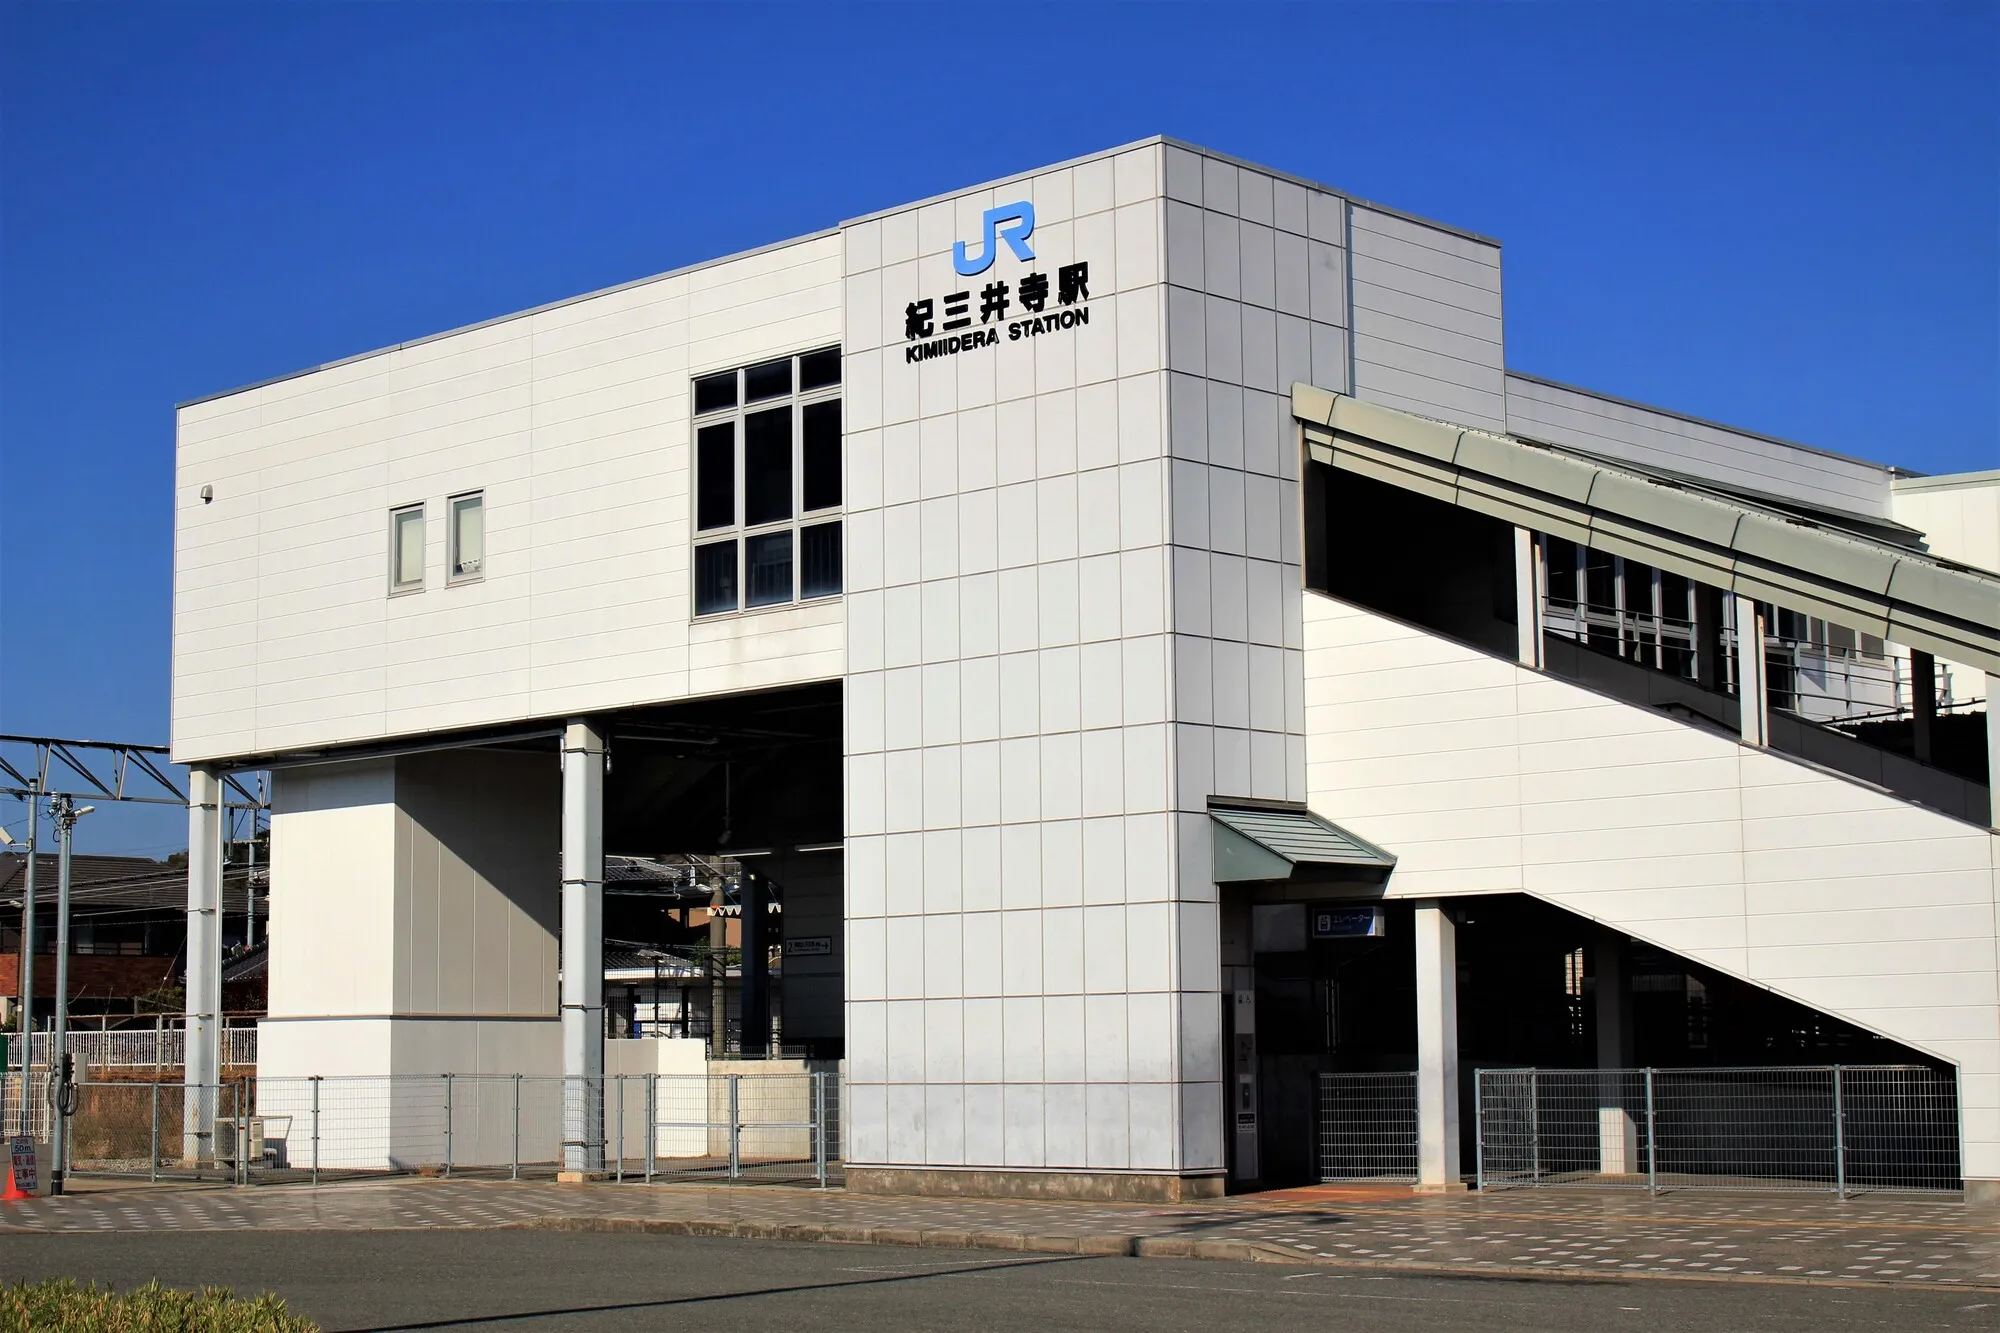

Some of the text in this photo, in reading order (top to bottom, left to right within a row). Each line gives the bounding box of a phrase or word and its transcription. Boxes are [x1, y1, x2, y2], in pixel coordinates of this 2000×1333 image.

[953, 200, 1036, 276] JR
[905, 261, 1089, 341] 紀三井寺駅
[905, 307, 1089, 364] KIMIIDERA STATION
[1332, 914, 1371, 923] エレベーター
[15, 1168, 35, 1180] 工事中
